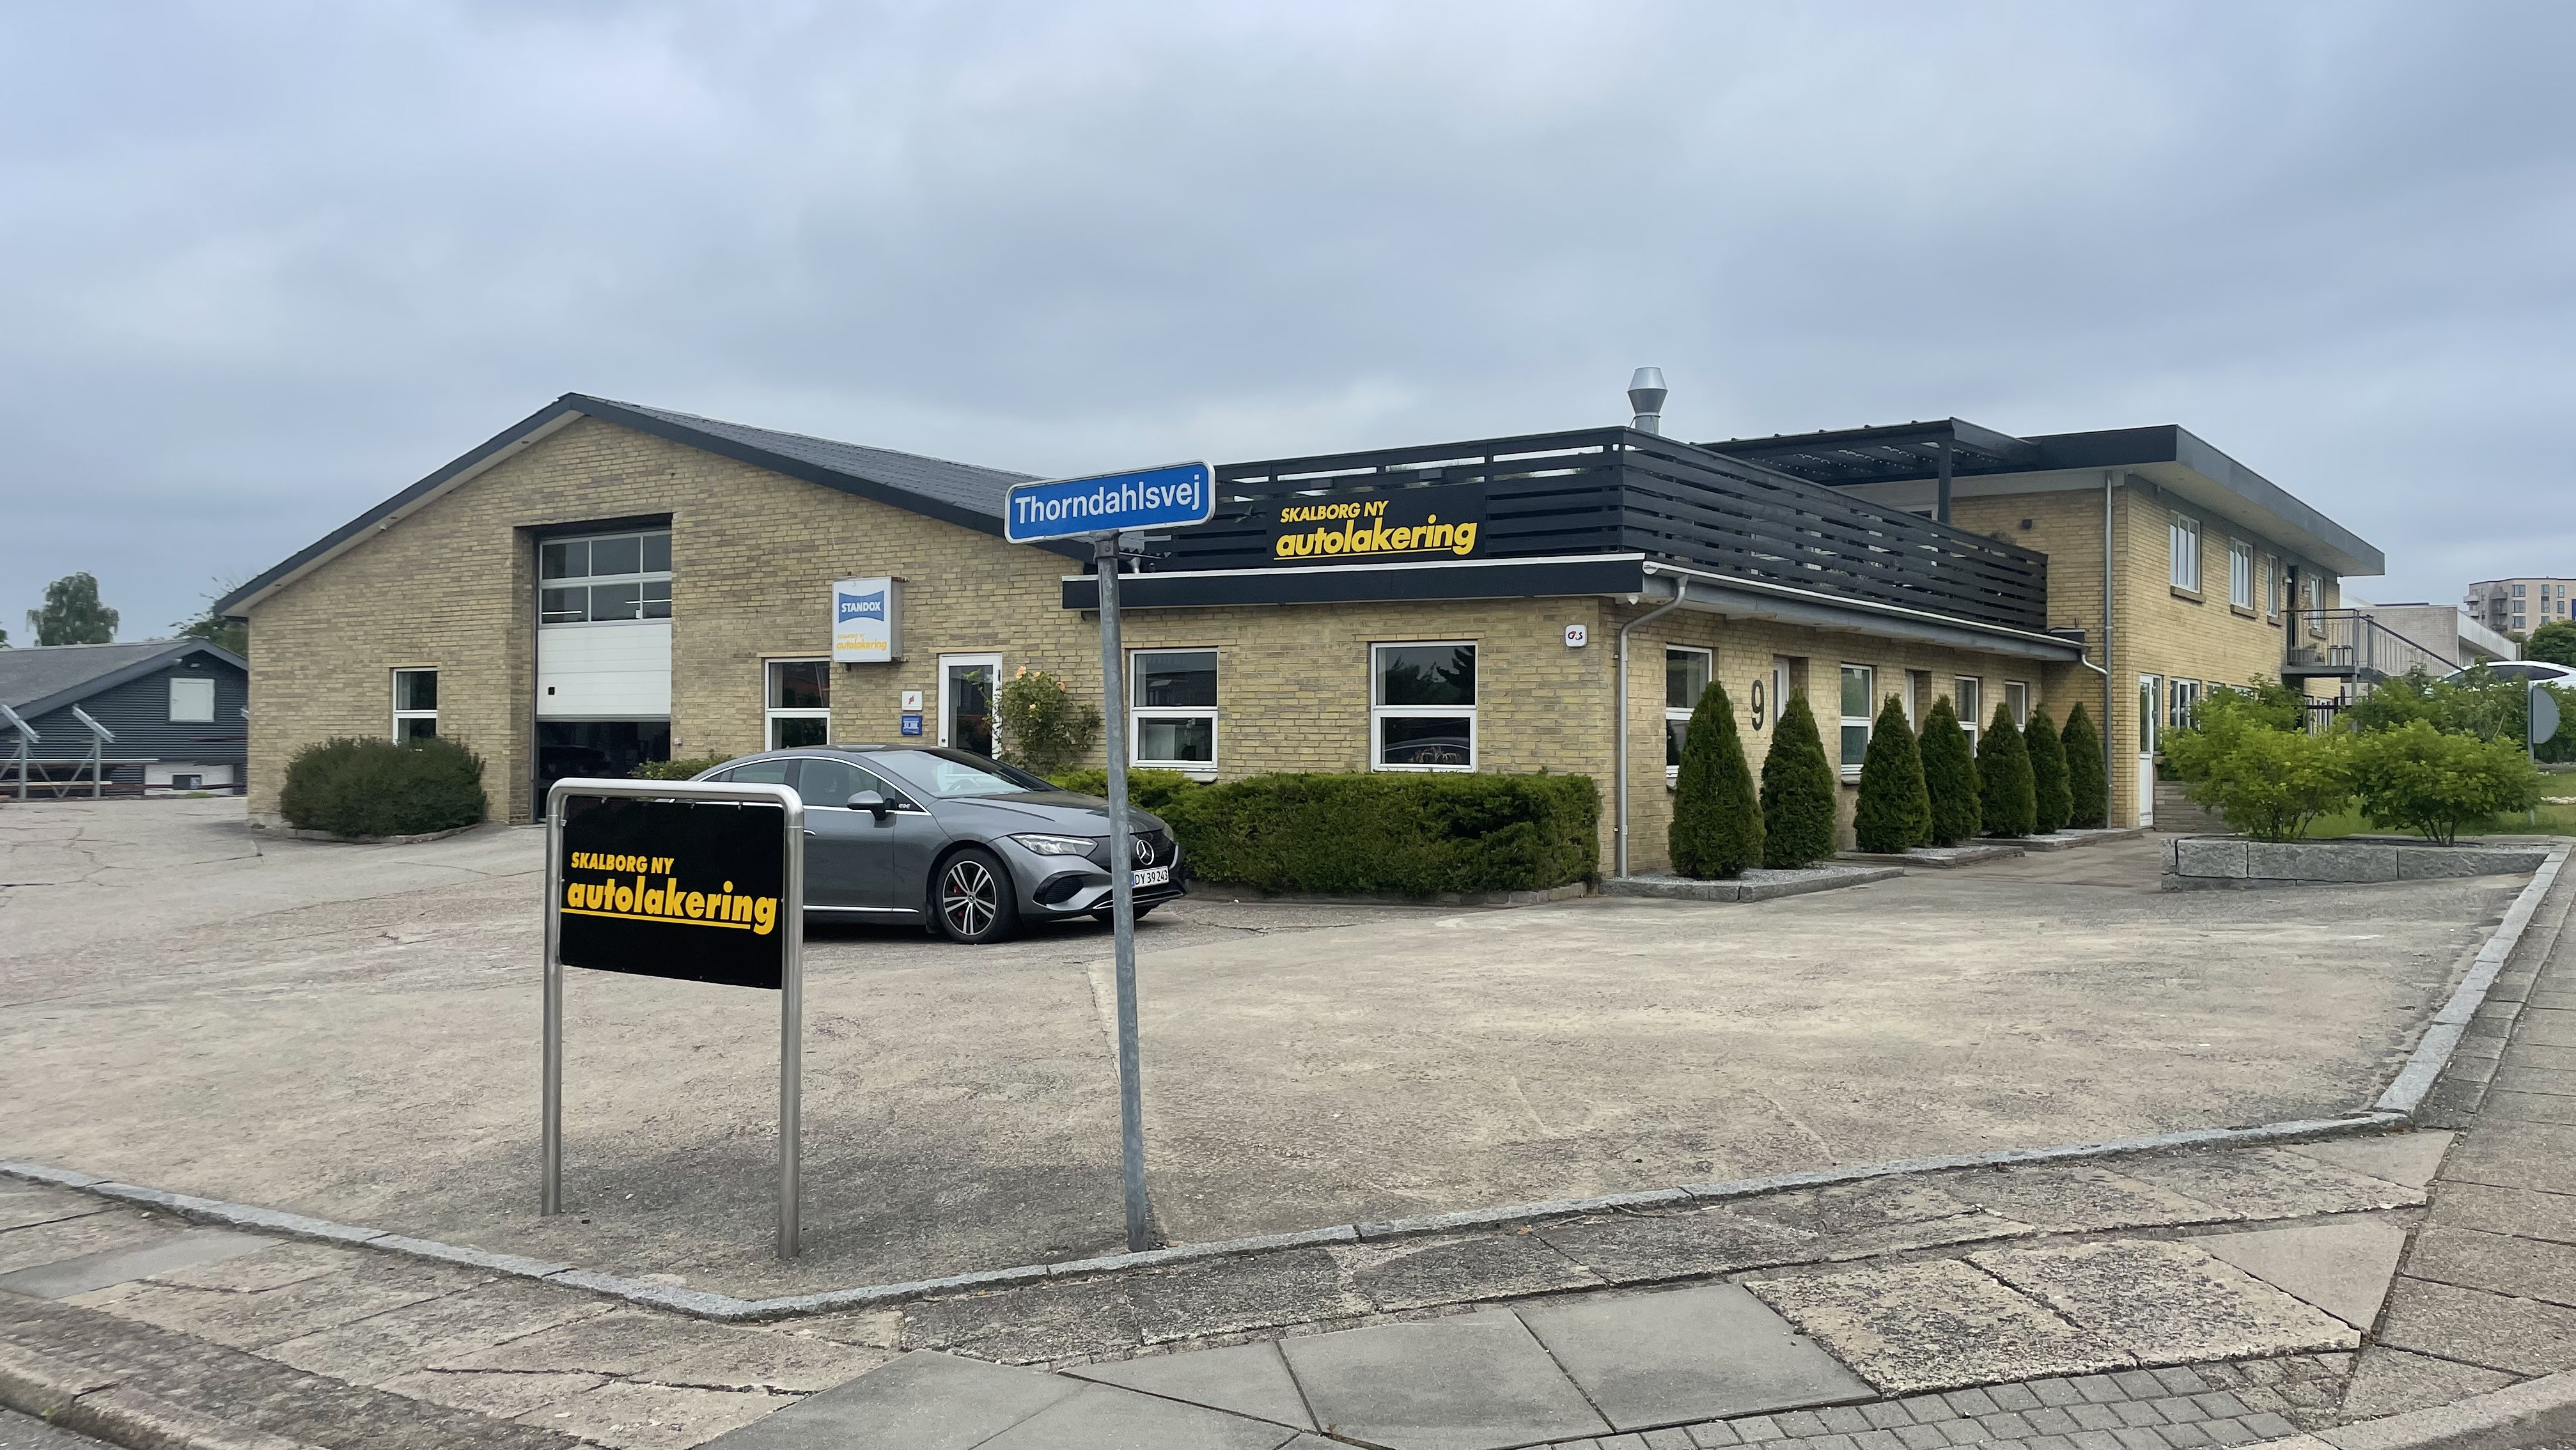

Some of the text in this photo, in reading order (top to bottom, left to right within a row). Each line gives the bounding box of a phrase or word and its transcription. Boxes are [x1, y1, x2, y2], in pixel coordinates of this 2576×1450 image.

[1015, 474, 1200, 524] Thorndahlsvej
[1280, 500, 1389, 523] SKALBORG NY
[1276, 514, 1478, 556] autolakering
[841, 601, 881, 613] STANDOX
[837, 638, 887, 651] autolakering
[1751, 679, 1765, 731] 9
[571, 852, 675, 875] SKALBORG NY
[1135, 869, 1168, 885] DY 39 243
[567, 875, 777, 935] autolakering
